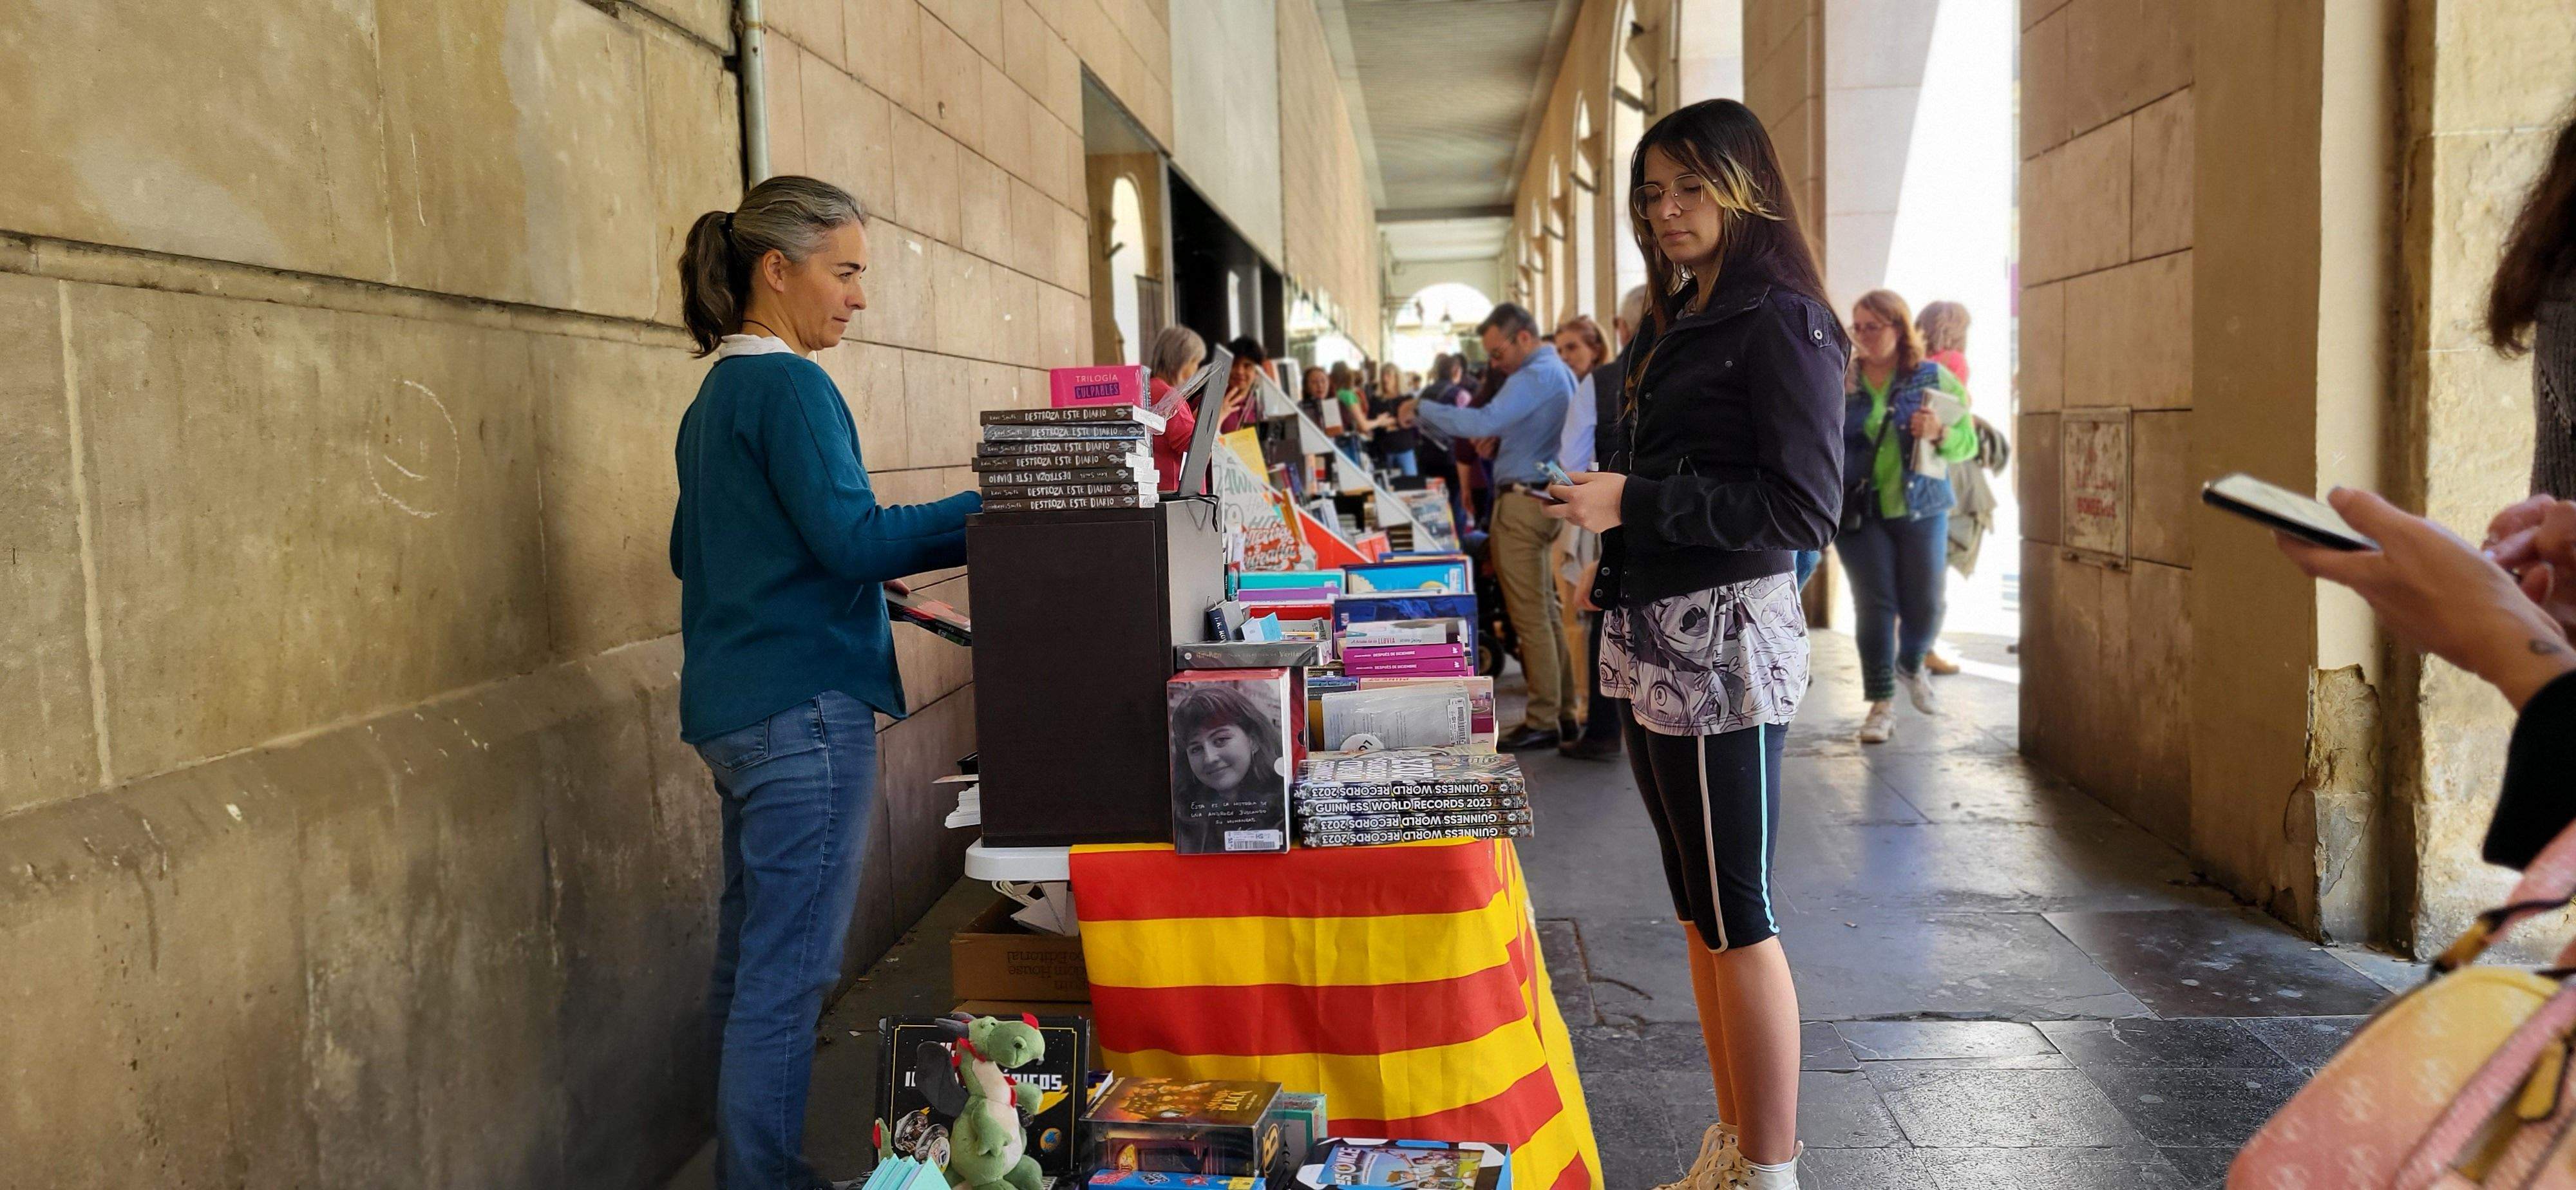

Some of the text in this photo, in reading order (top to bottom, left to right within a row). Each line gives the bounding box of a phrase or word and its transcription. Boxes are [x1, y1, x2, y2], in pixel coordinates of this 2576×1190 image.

[1025, 411, 1059, 421] DESTROZA
[1063, 410, 1080, 419] ESTE
[1083, 409, 1106, 419] DIARIO
[1032, 428, 1068, 437] DESTROZA
[1072, 428, 1090, 437] ESTE
[1094, 427, 1117, 436] DIARIO
[1025, 443, 1061, 453] DESTROZA
[1065, 442, 1082, 451] ESTE
[1086, 441, 1110, 451] DIARIO
[1016, 457, 1052, 467] DESTROZA
[1055, 456, 1072, 465] ESTE
[1075, 455, 1099, 465] DIARIO
[989, 473, 1012, 483] DIARIO
[1016, 473, 1032, 482] ESTE
[1036, 471, 1071, 481] DESTROZA
[1028, 486, 1063, 496] DESTROZA
[1067, 486, 1084, 495] ESTE
[1088, 484, 1111, 494] DIARIO
[1030, 500, 1066, 509] DESTROZA
[1070, 498, 1087, 508] ESTE
[1090, 498, 1114, 507] DIARIO
[1312, 761, 1334, 780] GUINNESS
[1336, 760, 1363, 780] WORLD
[1366, 760, 1388, 779] RECORDS
[1390, 759, 1434, 779] 2023
[1312, 784, 1489, 797] GUINNESS WORLD RECORDS 2023
[1316, 798, 1492, 813] GUINNESS WORLD RECORDS 2023
[1321, 814, 1497, 830] GUINNESS WORLD RECORDS 2023
[1321, 827, 1498, 844] GUINNESS WORLD RECORDS 2023
[1218, 1090, 1253, 1111] BLACK
